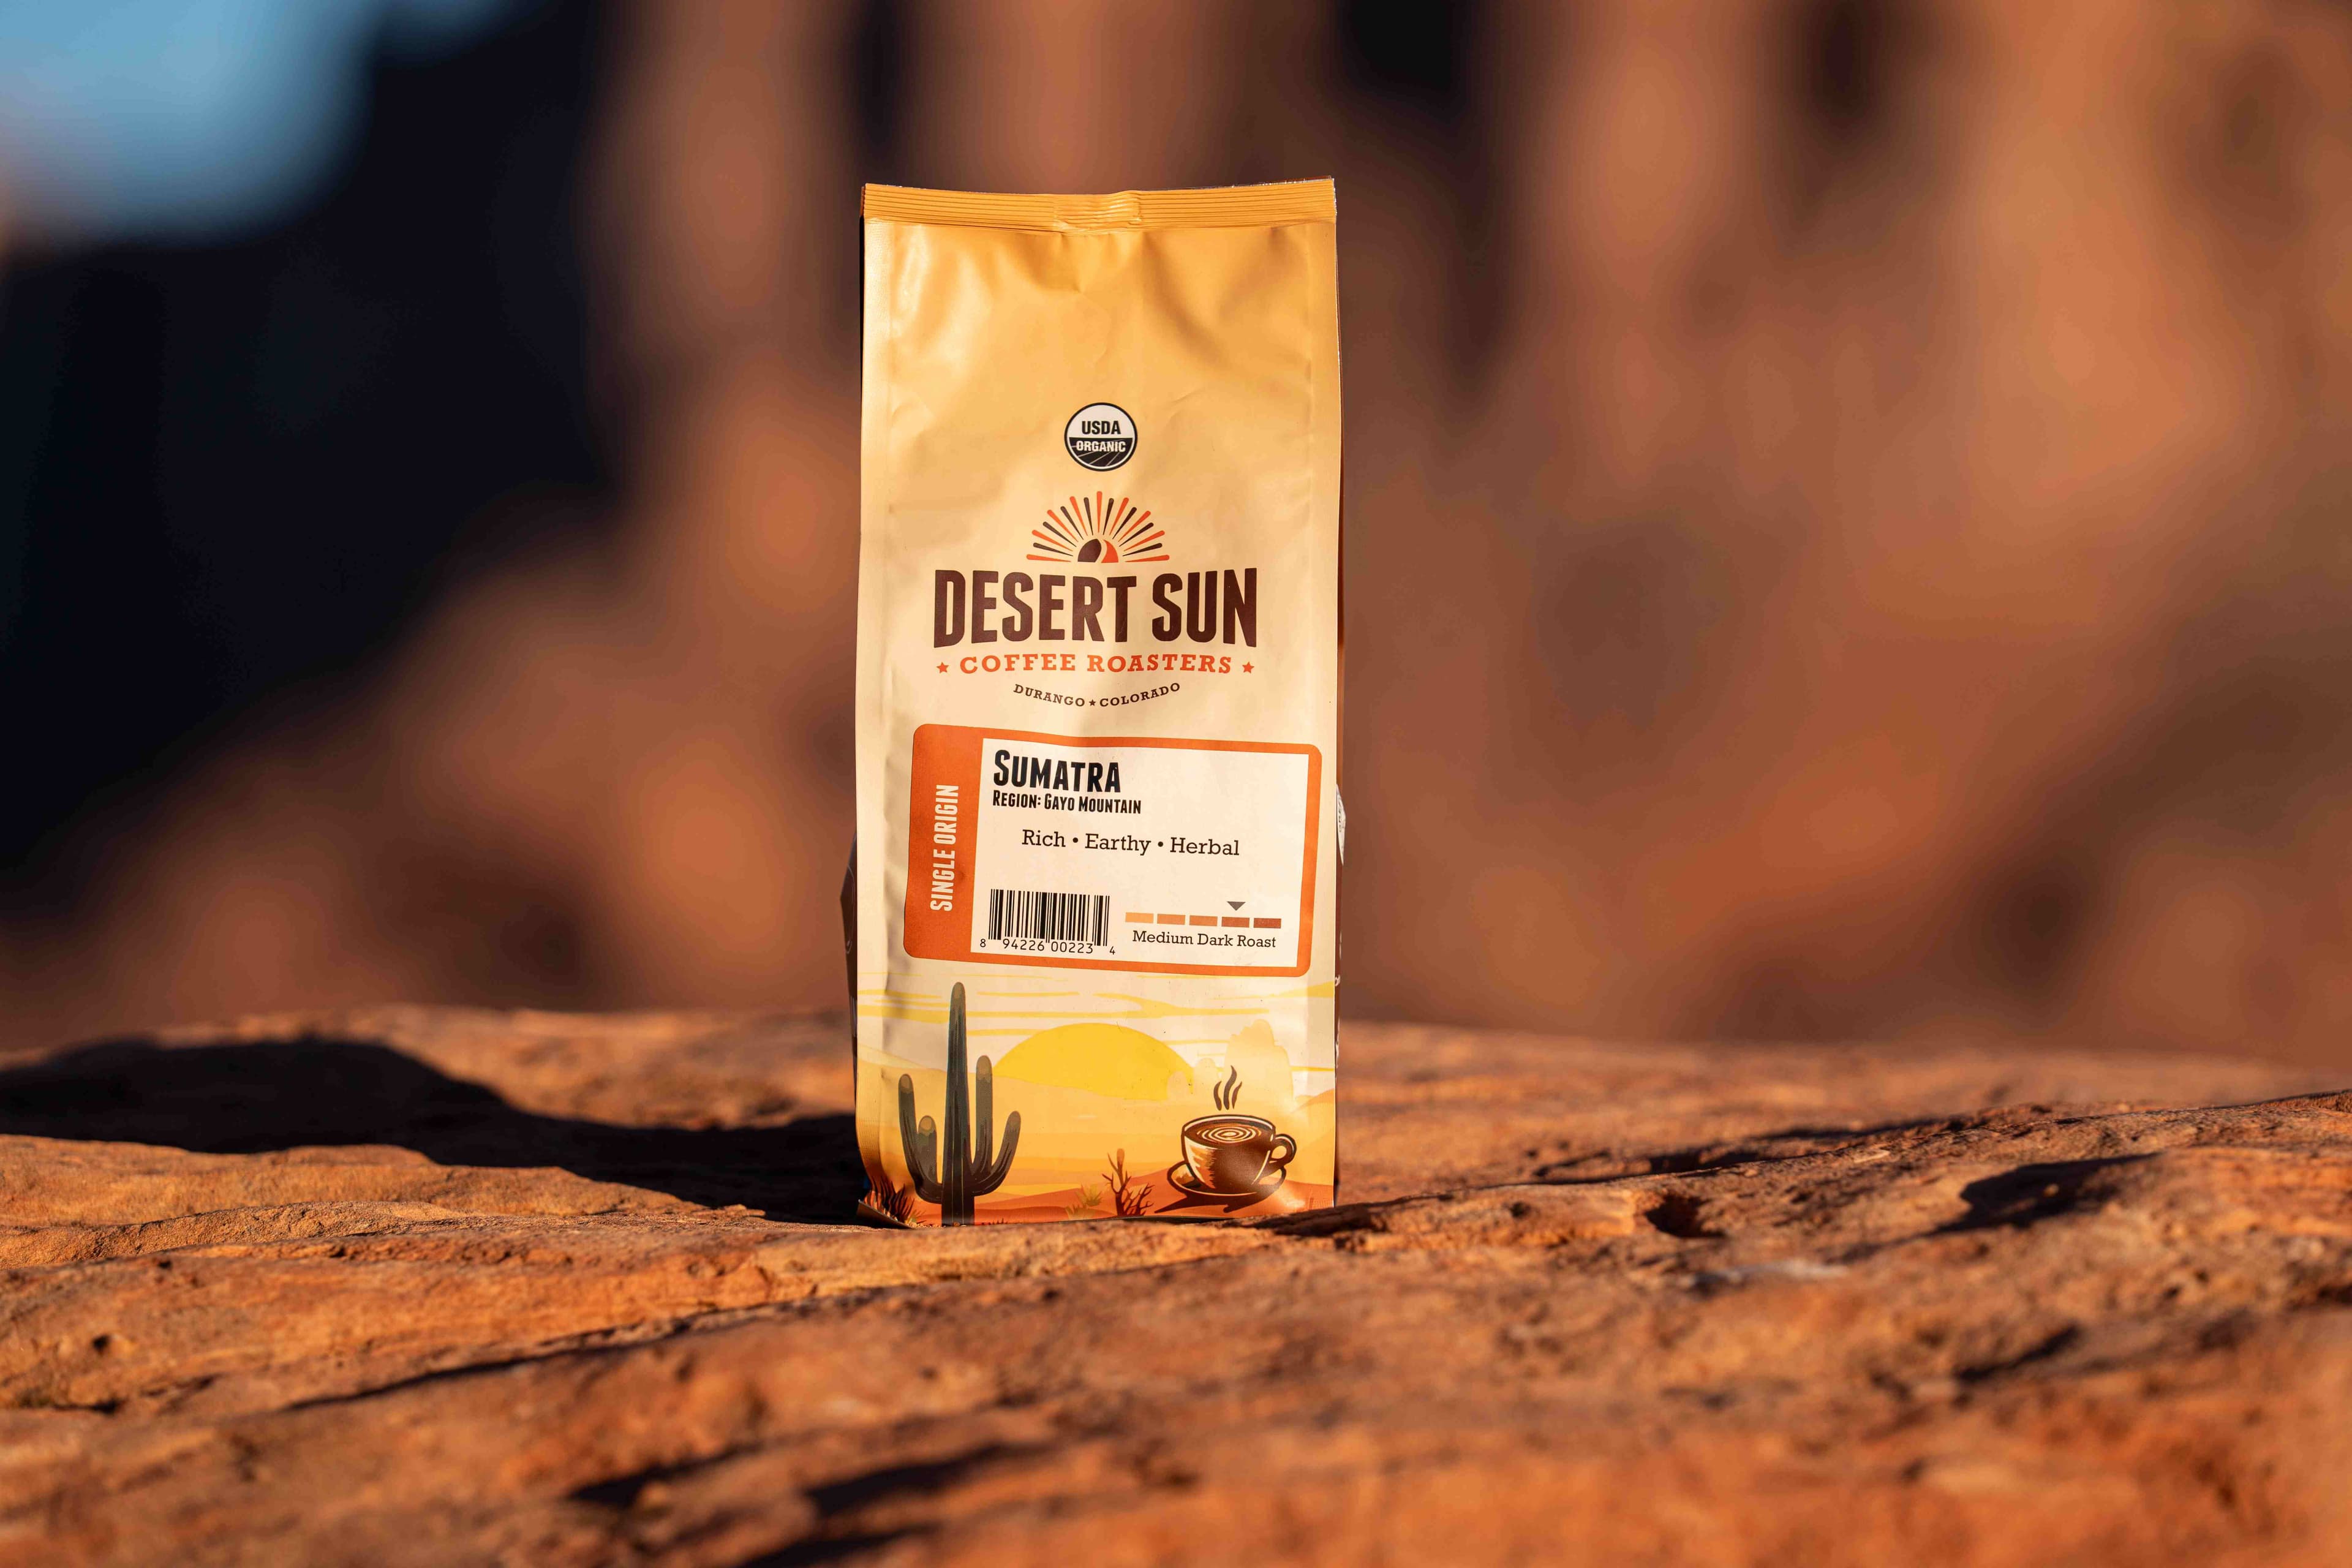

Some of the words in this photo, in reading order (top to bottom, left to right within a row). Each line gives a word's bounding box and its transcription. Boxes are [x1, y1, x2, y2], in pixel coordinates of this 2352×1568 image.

[1082, 420, 1121, 435] USDA
[1076, 440, 1126, 452] ORGANIC
[933, 570, 1137, 648] DESERT
[1152, 567, 1257, 648] SUN
[960, 654, 1076, 674] COFFEE
[1087, 654, 1231, 674] ROASTERS
[1013, 683, 1085, 707] DURANGO
[1099, 682, 1181, 707] COLORADO
[993, 749, 1121, 793] SUMATRA
[992, 790, 1041, 809] REGION:
[1044, 793, 1075, 811] GAYO
[1078, 796, 1142, 814] MOUNTAIN
[933, 785, 959, 845] ORIGIN
[1022, 829, 1066, 848] Rich
[1085, 833, 1152, 856] Earthy
[1170, 837, 1240, 856] Herbal
[930, 849, 956, 911] SINGLE
[979, 938, 986, 948] 8
[1003, 938, 1045, 951] 94226
[1051, 941, 1093, 954] 00223
[1109, 946, 1115, 955] 4
[1132, 930, 1194, 944] Medium
[1197, 933, 1234, 946] Dark
[1237, 935, 1276, 948] Roast
